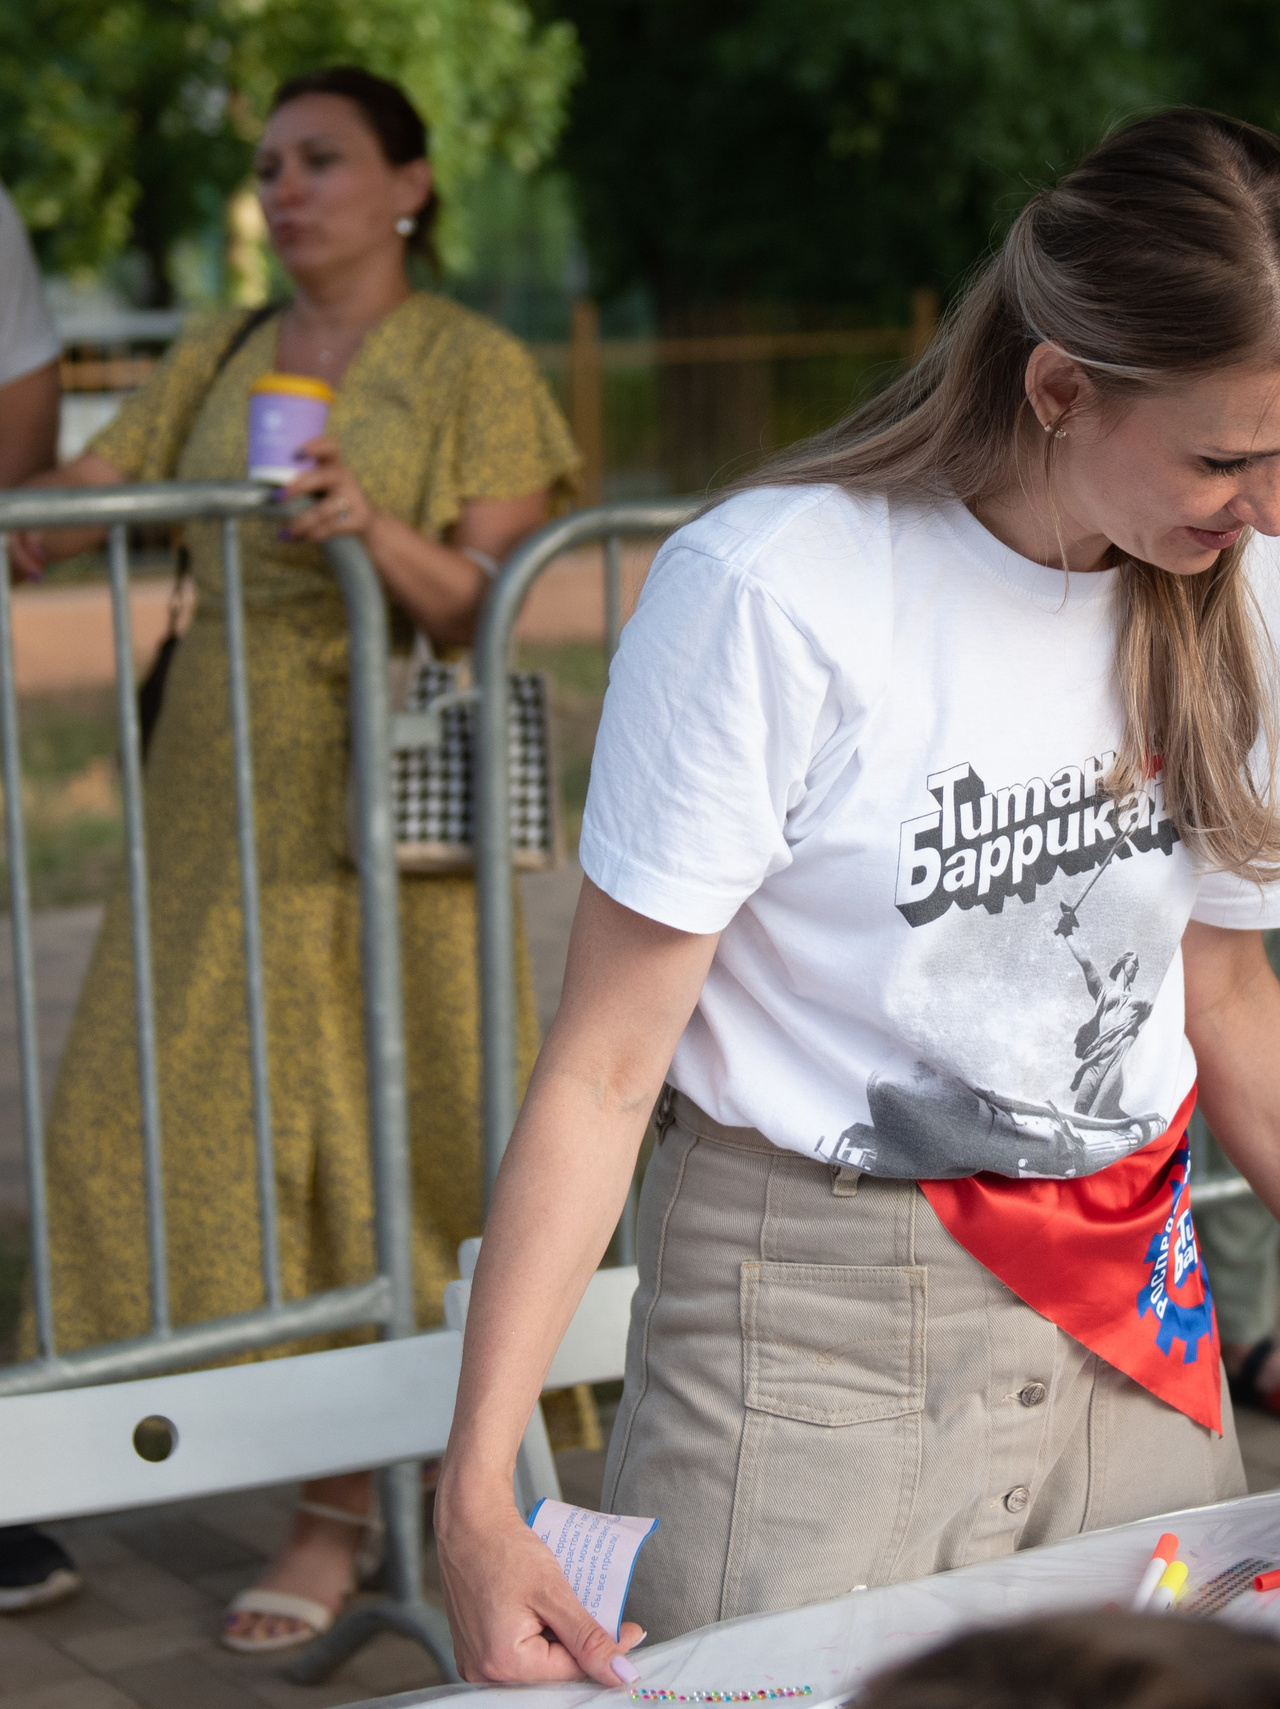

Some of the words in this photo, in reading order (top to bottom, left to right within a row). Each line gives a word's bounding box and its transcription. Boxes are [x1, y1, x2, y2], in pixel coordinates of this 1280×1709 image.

[578, 1534, 592, 1563] может
[581, 1555, 599, 1607] аничение
[590, 1593, 602, 1608] бы
[597, 1573, 607, 1591] все
